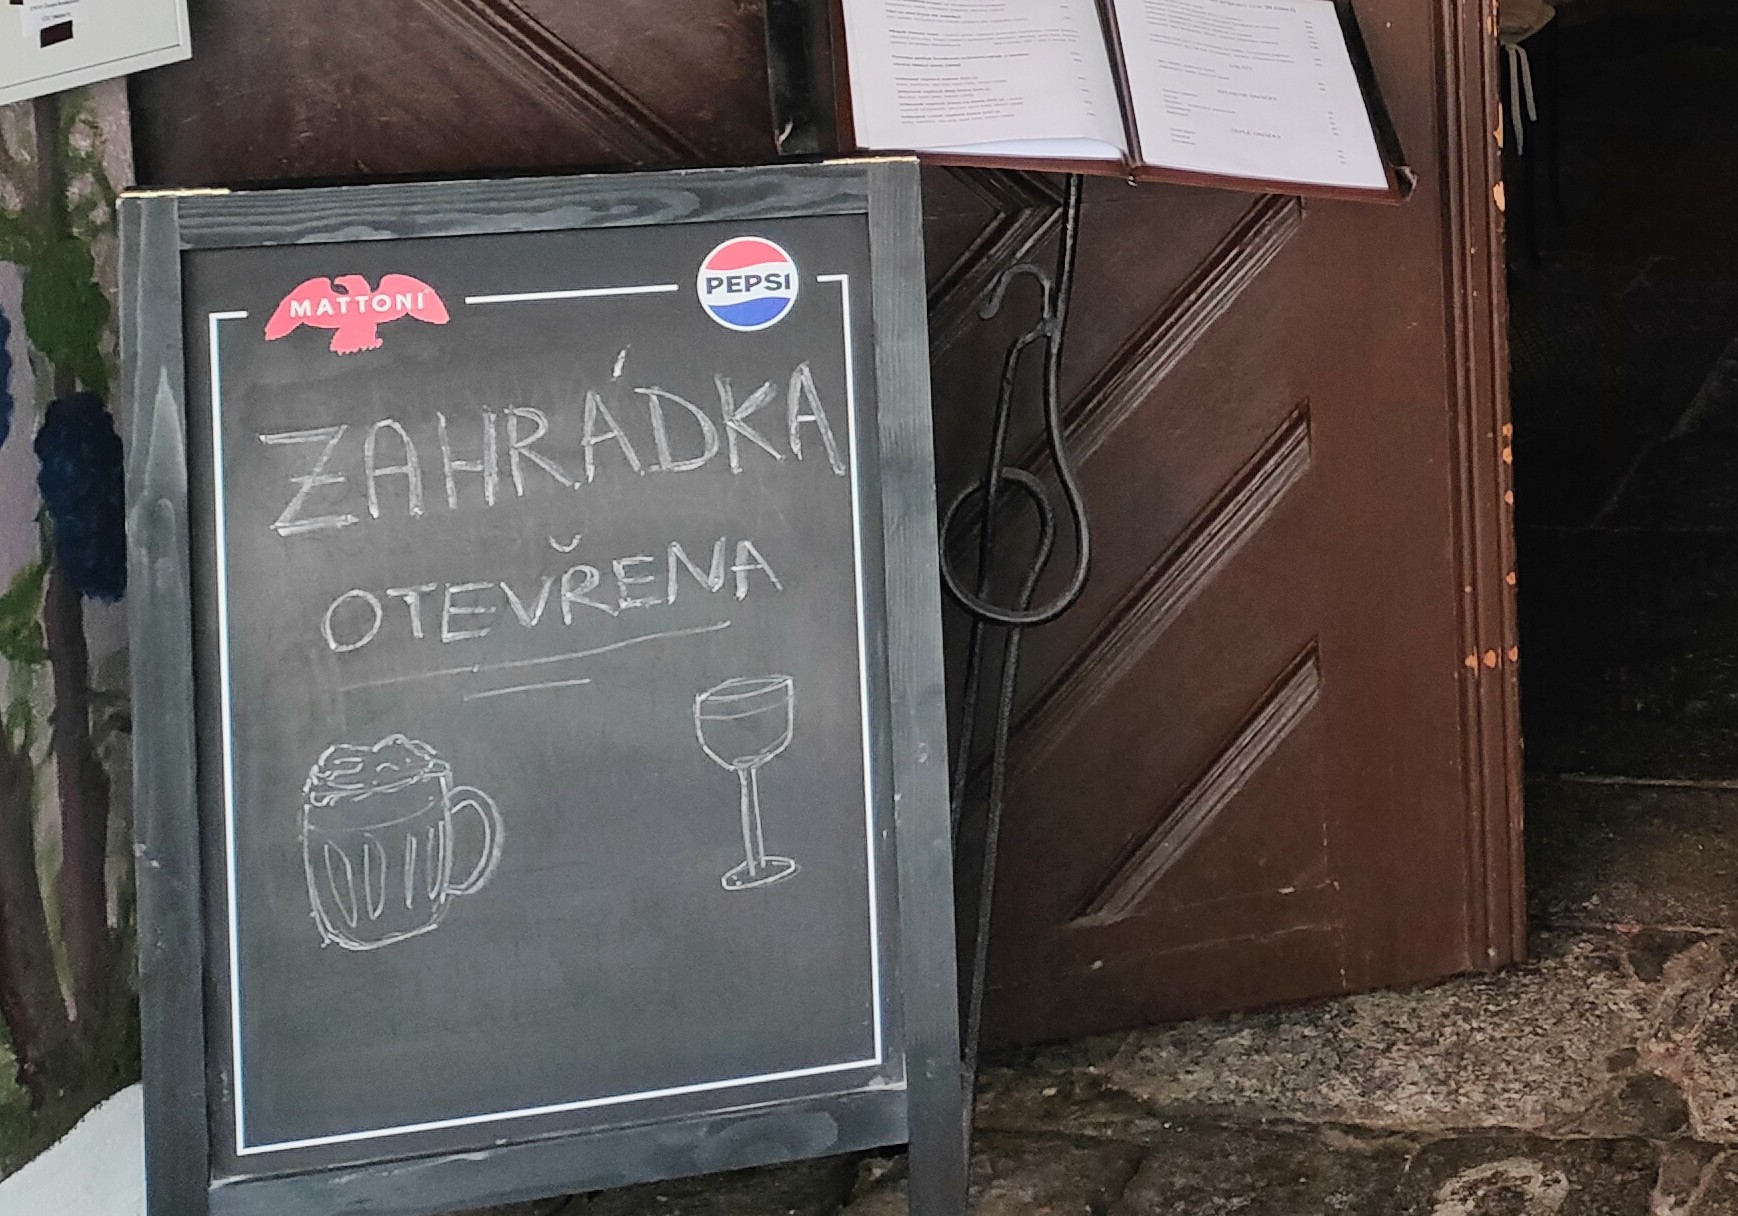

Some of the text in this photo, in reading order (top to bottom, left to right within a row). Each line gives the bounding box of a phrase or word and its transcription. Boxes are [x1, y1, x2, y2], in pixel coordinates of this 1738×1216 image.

[289, 291, 425, 318] MATTONI
[705, 272, 791, 295] PEPSI
[259, 344, 847, 536] ZAHRÁDKA
[320, 533, 784, 654] OTEVŘENA
